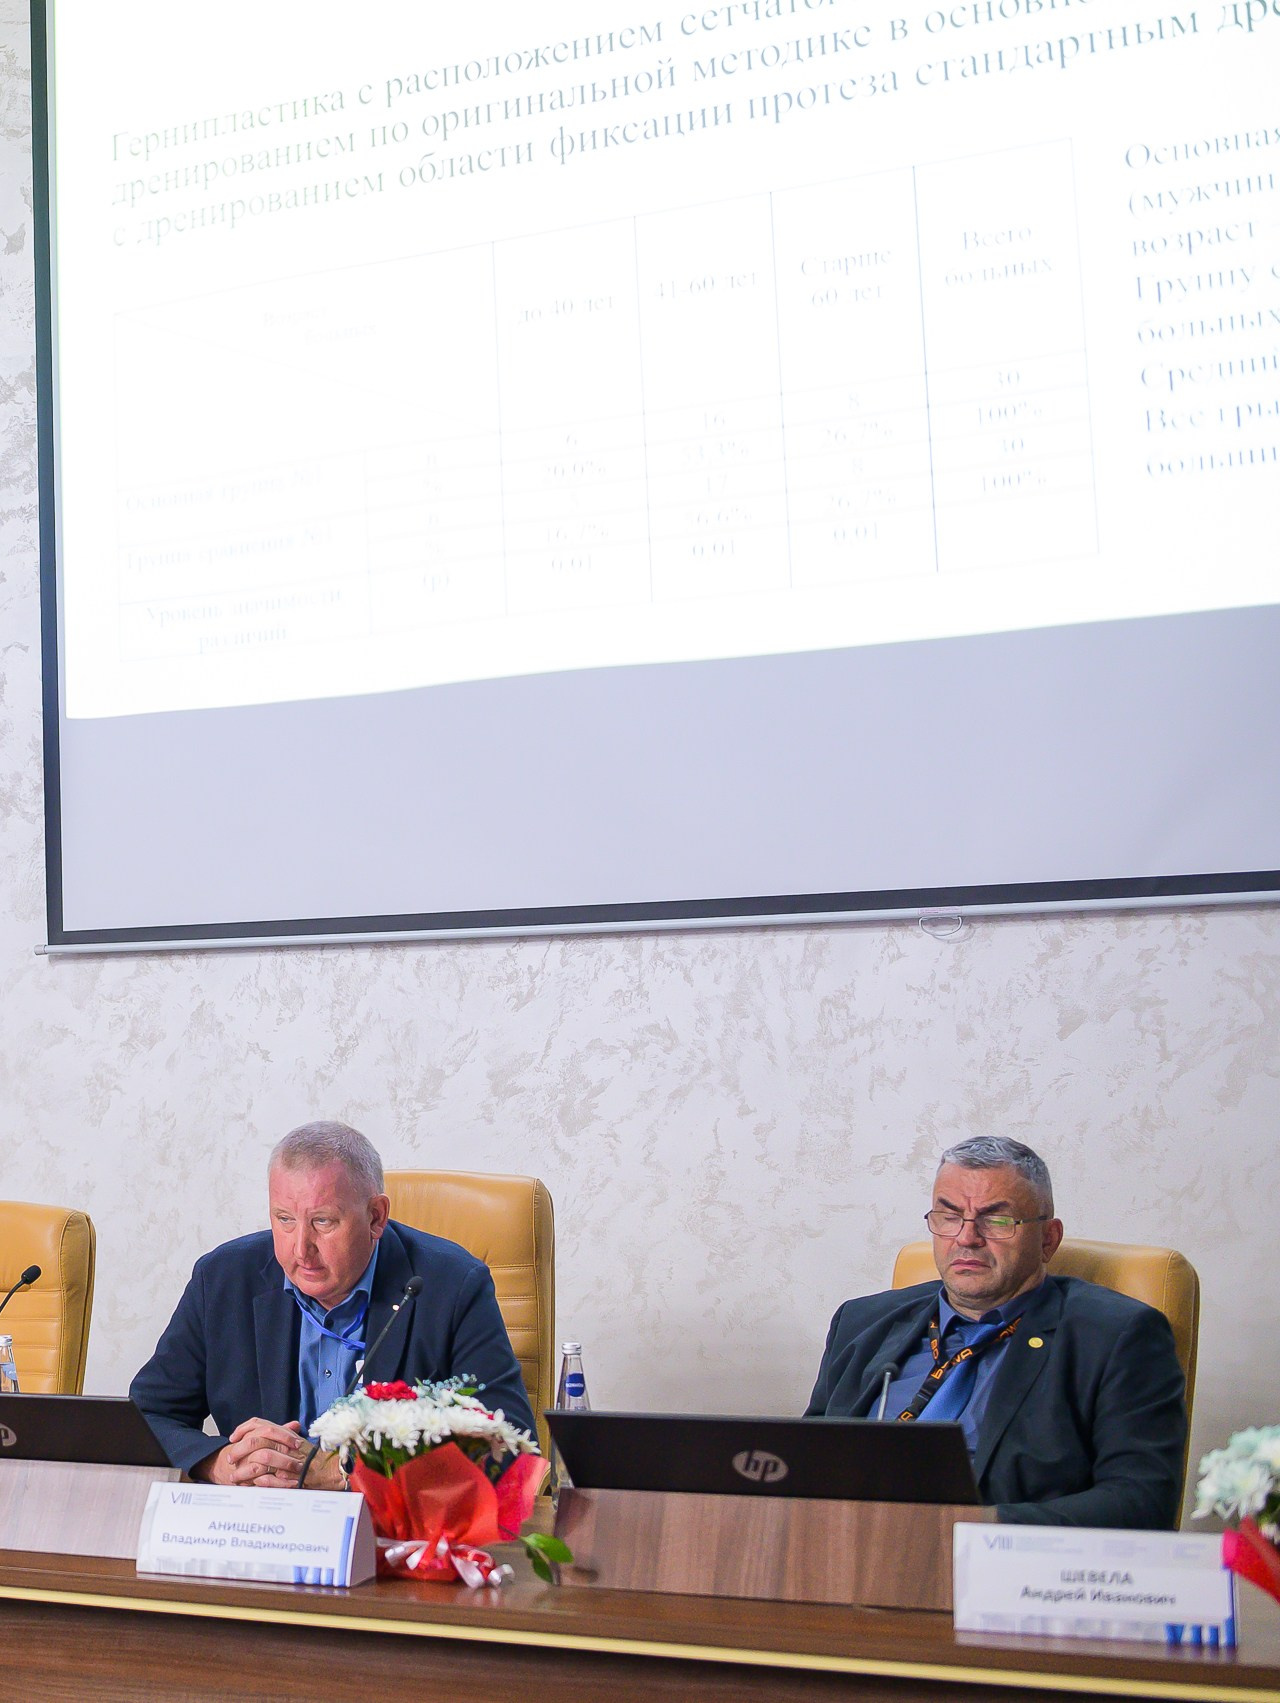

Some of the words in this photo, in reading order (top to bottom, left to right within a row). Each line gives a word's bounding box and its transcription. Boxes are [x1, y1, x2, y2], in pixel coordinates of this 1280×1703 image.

[111, 89, 346, 162] Гернипластика
[358, 83, 374, 105] с
[384, 21, 663, 108] расположением
[111, 132, 356, 208] дренированием
[369, 121, 409, 149] по
[421, 57, 677, 142] оригинальной
[692, 25, 872, 82] методике
[888, 18, 909, 43] в
[112, 225, 126, 247] с
[136, 169, 385, 248] дренированием
[398, 141, 535, 191] области
[548, 101, 734, 166] фиксации
[747, 68, 899, 125] протеза
[914, 11, 1201, 87] стандартным
[962, 224, 1033, 251] Всего
[1132, 219, 1261, 257] возраст
[799, 246, 893, 280] Старше
[943, 254, 1054, 288] больных
[809, 287, 838, 308] 60
[846, 281, 883, 303] лет
[1135, 265, 1258, 304] Группу
[1144, 406, 1207, 434] Все
[736, 1450, 785, 1483] hp
[170, 1491, 192, 1505] VIII
[161, 1532, 227, 1549] Владимир
[230, 1536, 330, 1554] Владимирович
[207, 1520, 286, 1536] АНИЩЕНКО
[1059, 1569, 1134, 1585] ШЕВЕЛА
[1020, 1584, 1087, 1604] Андрей
[1090, 1588, 1177, 1606] Иванович
